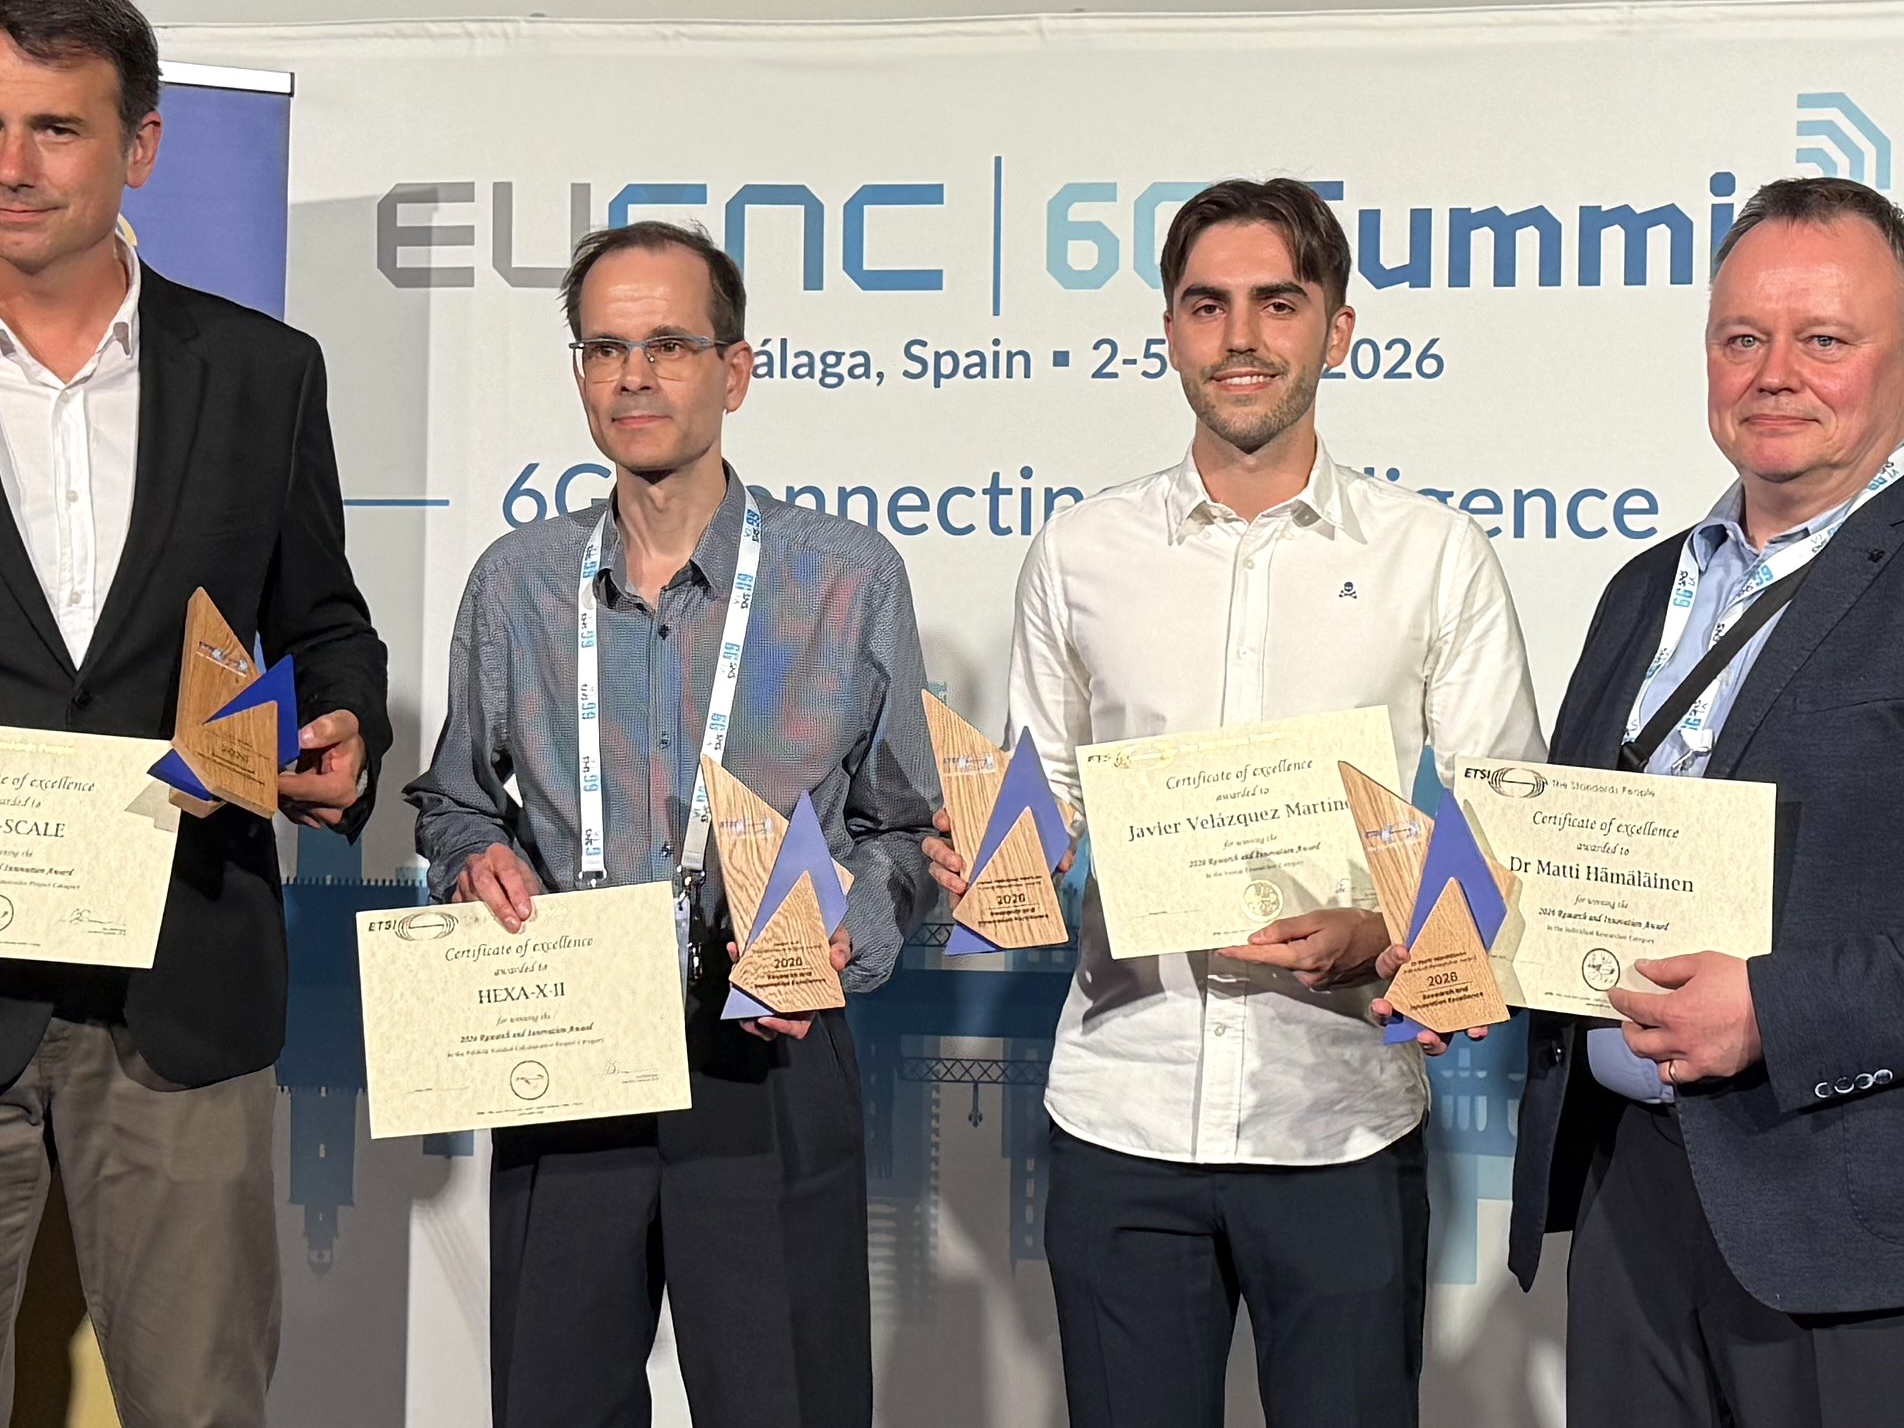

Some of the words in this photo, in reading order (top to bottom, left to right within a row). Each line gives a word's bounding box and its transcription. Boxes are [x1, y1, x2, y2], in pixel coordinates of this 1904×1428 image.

[751, 337, 885, 389] álaga,
[902, 337, 1032, 389] Spain
[1091, 338, 1167, 379] 2-5
[1672, 586, 1694, 609] 6G
[12, 771, 28, 790] of
[29, 773, 95, 792] excellence
[1165, 769, 1232, 790] Certificate
[1235, 765, 1250, 783] of
[1252, 758, 1314, 778] excellence
[1464, 767, 1491, 779] ETSI
[1127, 817, 1182, 842] Javier
[1185, 806, 1281, 832] Velázquez
[1533, 811, 1597, 830] Certificate
[1600, 815, 1615, 835] of
[1616, 820, 1680, 839] excellence
[1576, 842, 1618, 855] awarded
[1619, 847, 1630, 856] to
[1509, 856, 1532, 874] Dr
[1537, 859, 1580, 880] Matti
[1586, 865, 1694, 893] Hämäläinen
[368, 920, 397, 933] ETSI
[445, 942, 512, 962] Certificate
[516, 939, 531, 958] of
[532, 935, 594, 954] excellence
[478, 982, 566, 1004] HEXA-X-II
